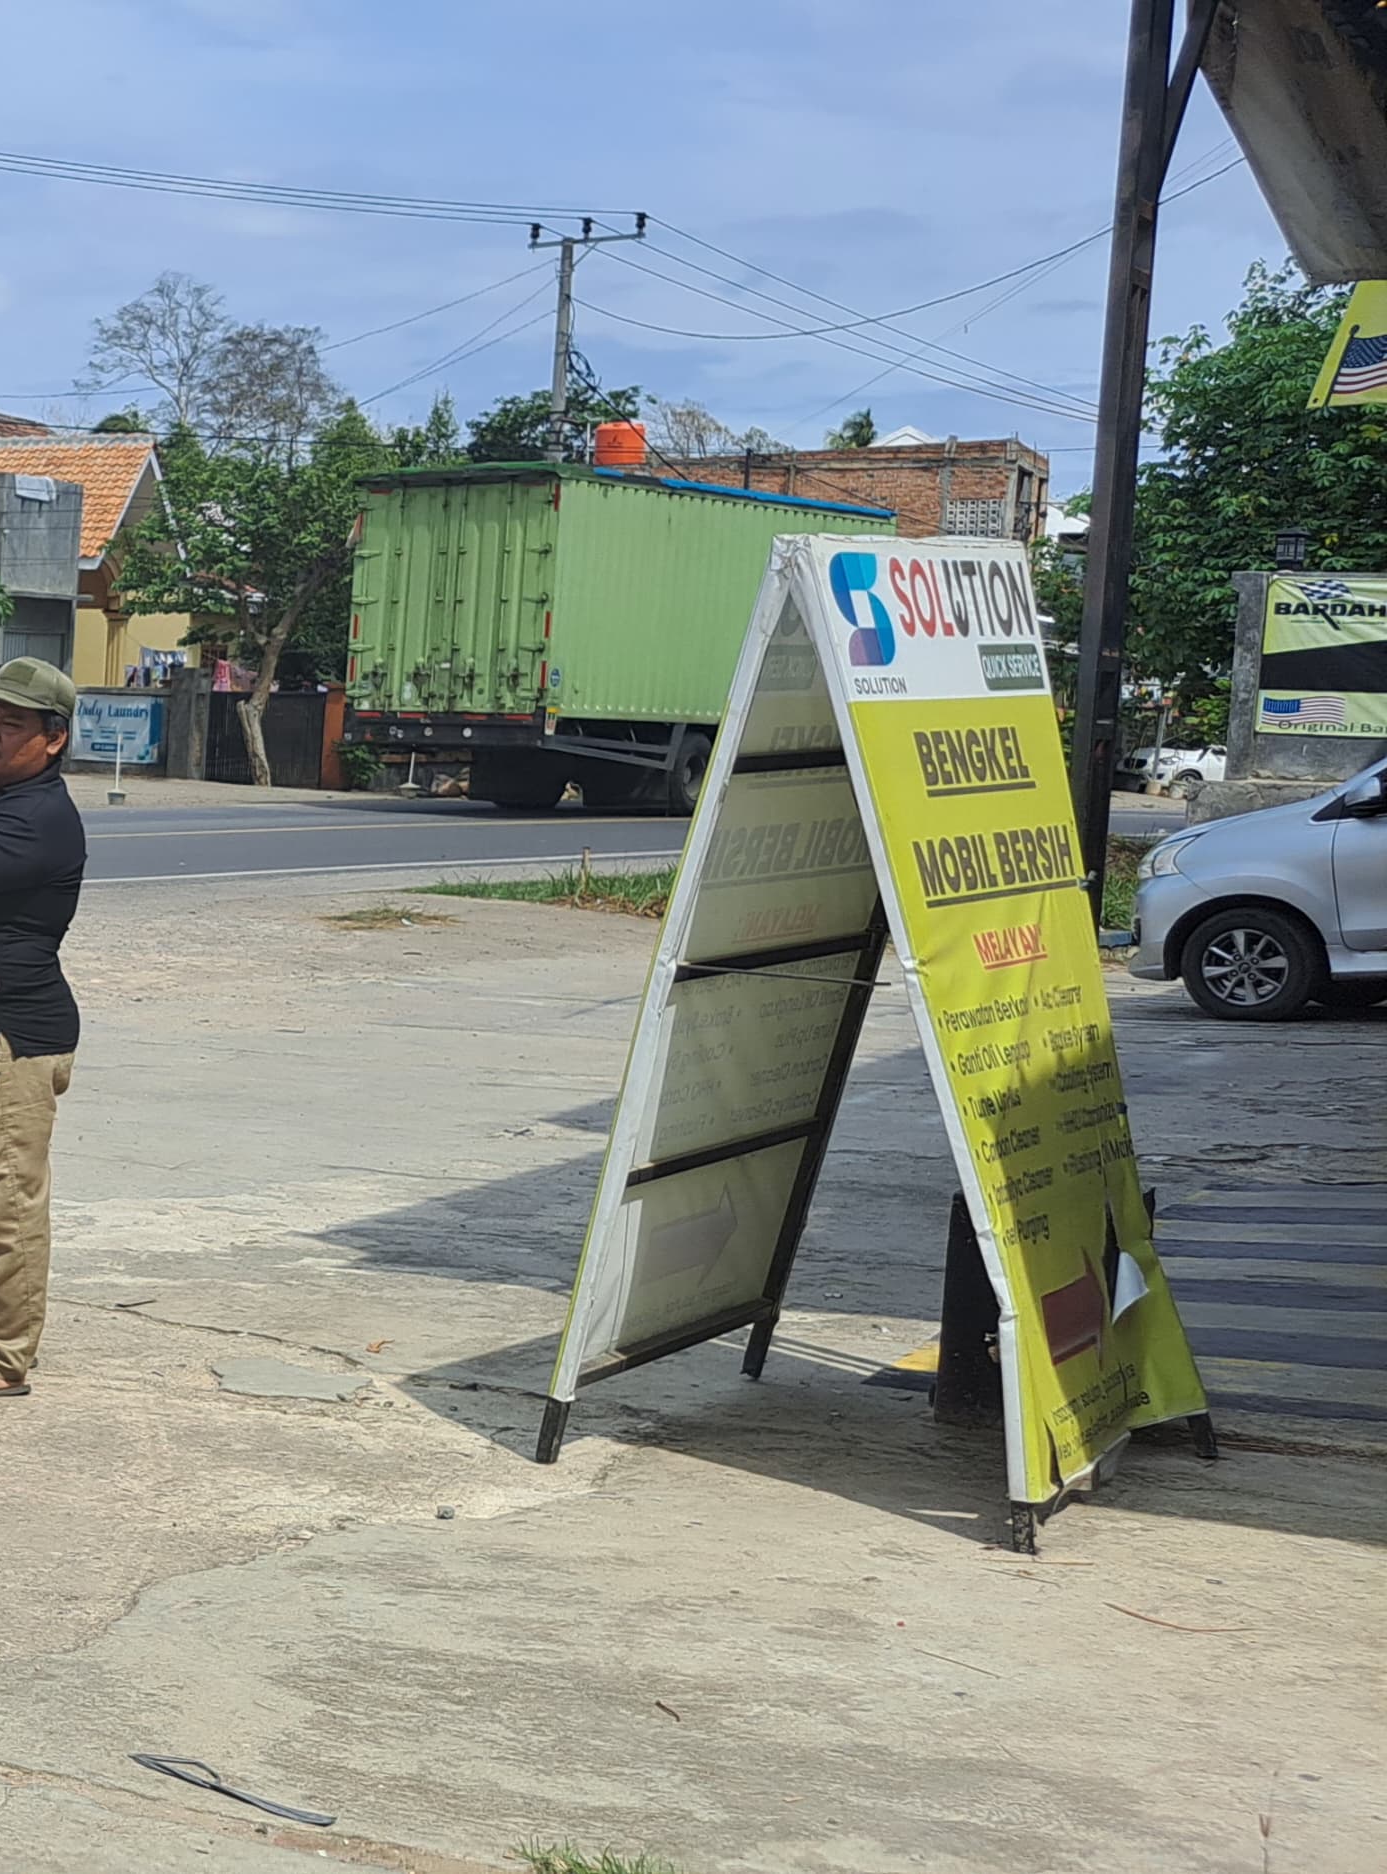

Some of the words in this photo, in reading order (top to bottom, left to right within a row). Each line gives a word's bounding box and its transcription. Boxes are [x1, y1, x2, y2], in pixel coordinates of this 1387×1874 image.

[889, 557, 1035, 638] SOLUTION
[854, 677, 908, 695] SOLUTION
[982, 655, 1009, 679] QUICK
[1009, 654, 1042, 679] SERVICE
[913, 726, 1031, 786] BENGKEL
[912, 832, 999, 898] MOBIL
[993, 824, 1075, 886] BERSIH
[968, 1096, 996, 1120] Tune
